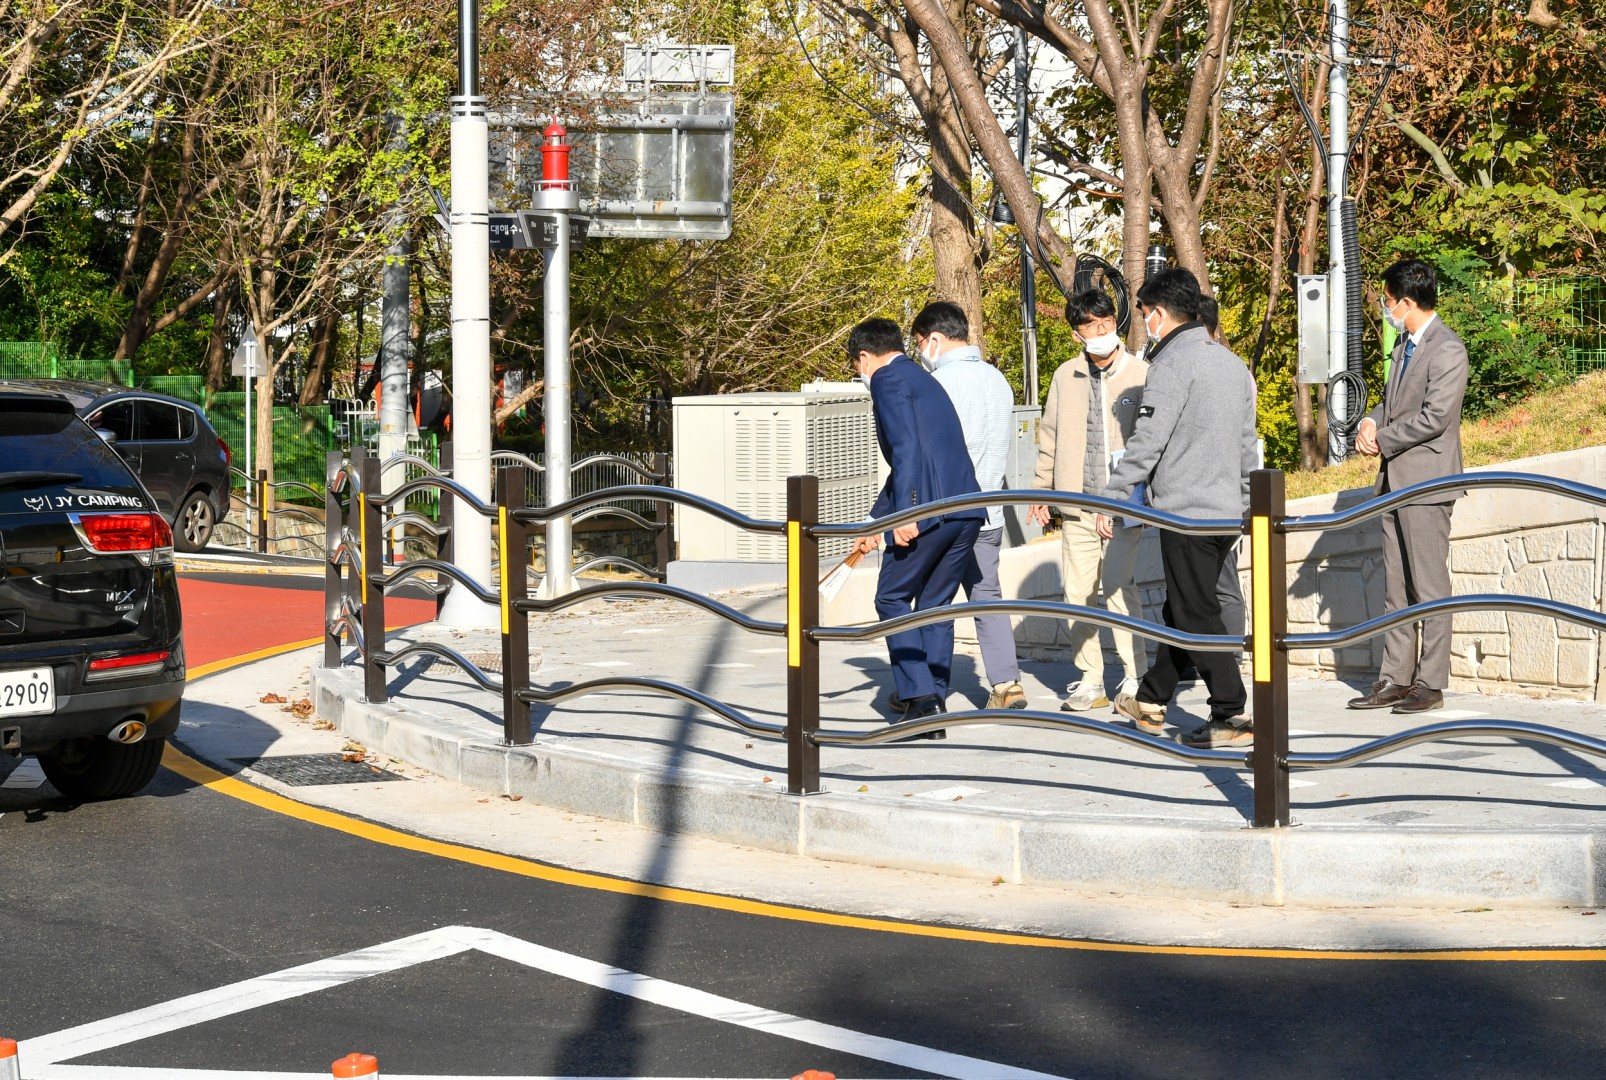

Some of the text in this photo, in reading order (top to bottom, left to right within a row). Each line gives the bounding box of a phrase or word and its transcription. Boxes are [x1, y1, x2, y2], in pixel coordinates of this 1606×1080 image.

[55, 495, 143, 508] JY CAMPING
[106, 588, 136, 604] MKX
[4, 681, 49, 707] 2909
